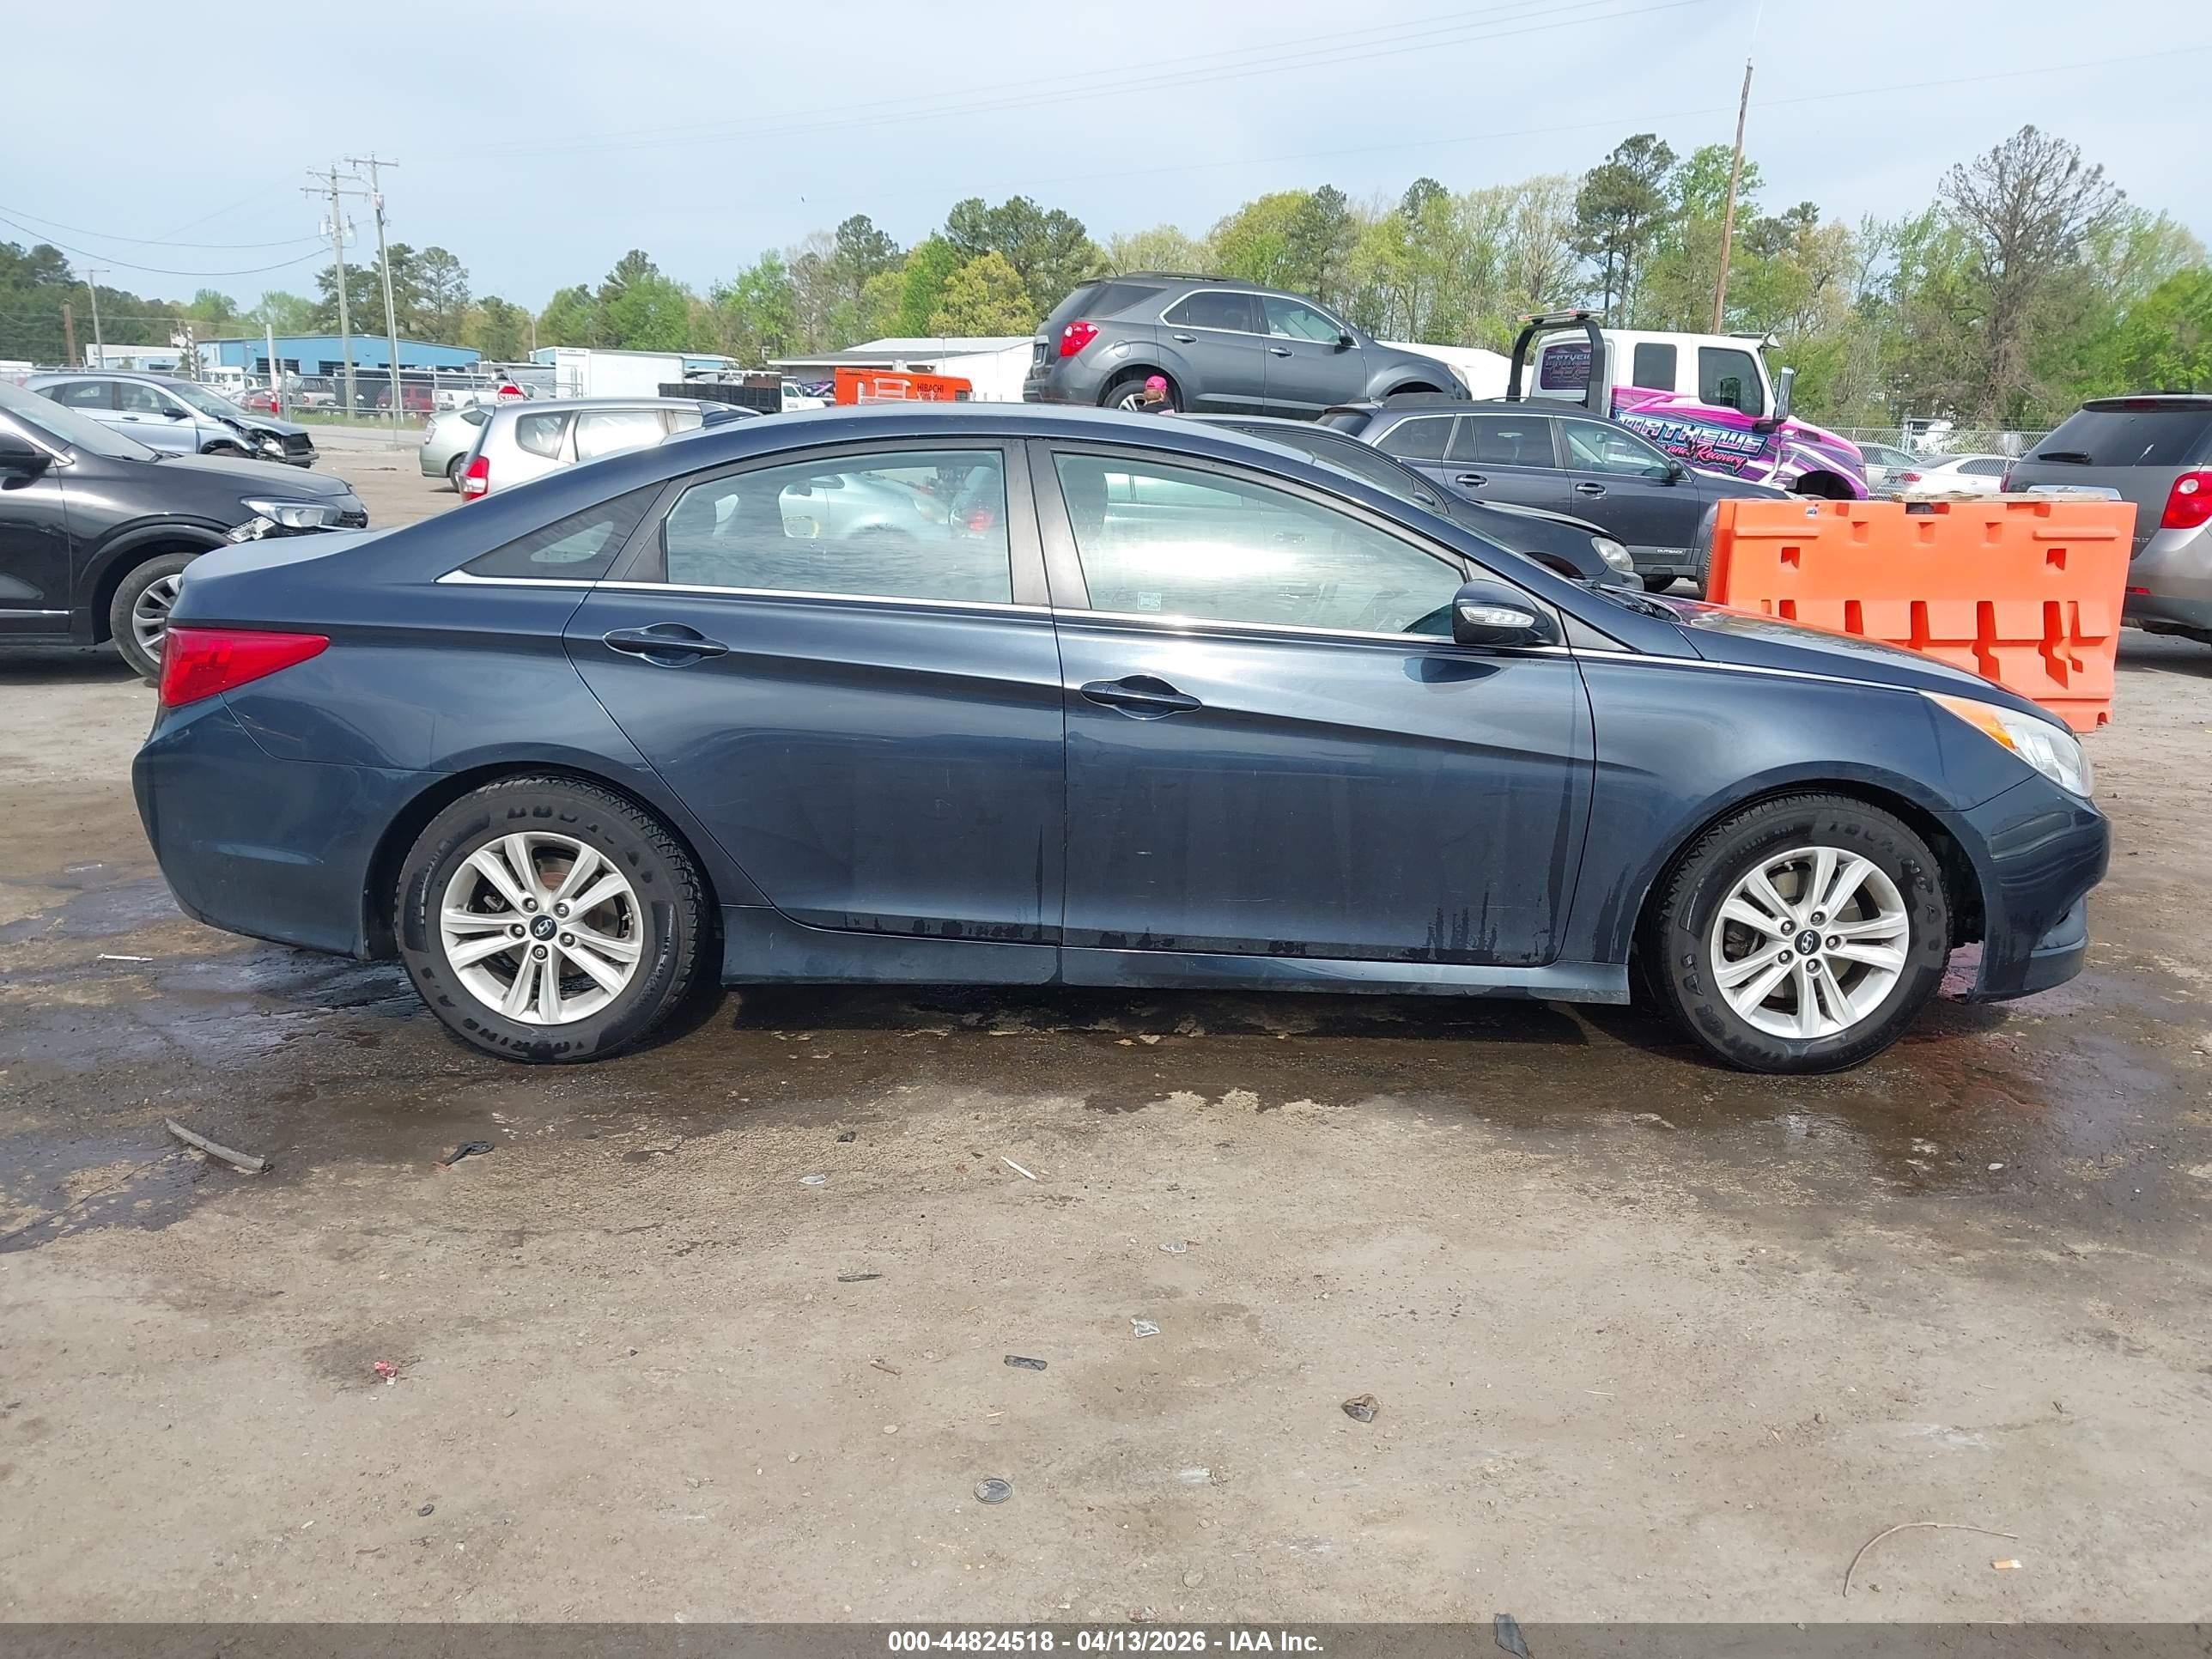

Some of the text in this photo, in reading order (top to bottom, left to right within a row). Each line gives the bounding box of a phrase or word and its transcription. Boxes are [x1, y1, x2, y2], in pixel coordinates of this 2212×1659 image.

[917, 382, 944, 392] HIBACHI
[1617, 414, 1765, 453] MATHEWS
[1697, 443, 1746, 469] Recovery
